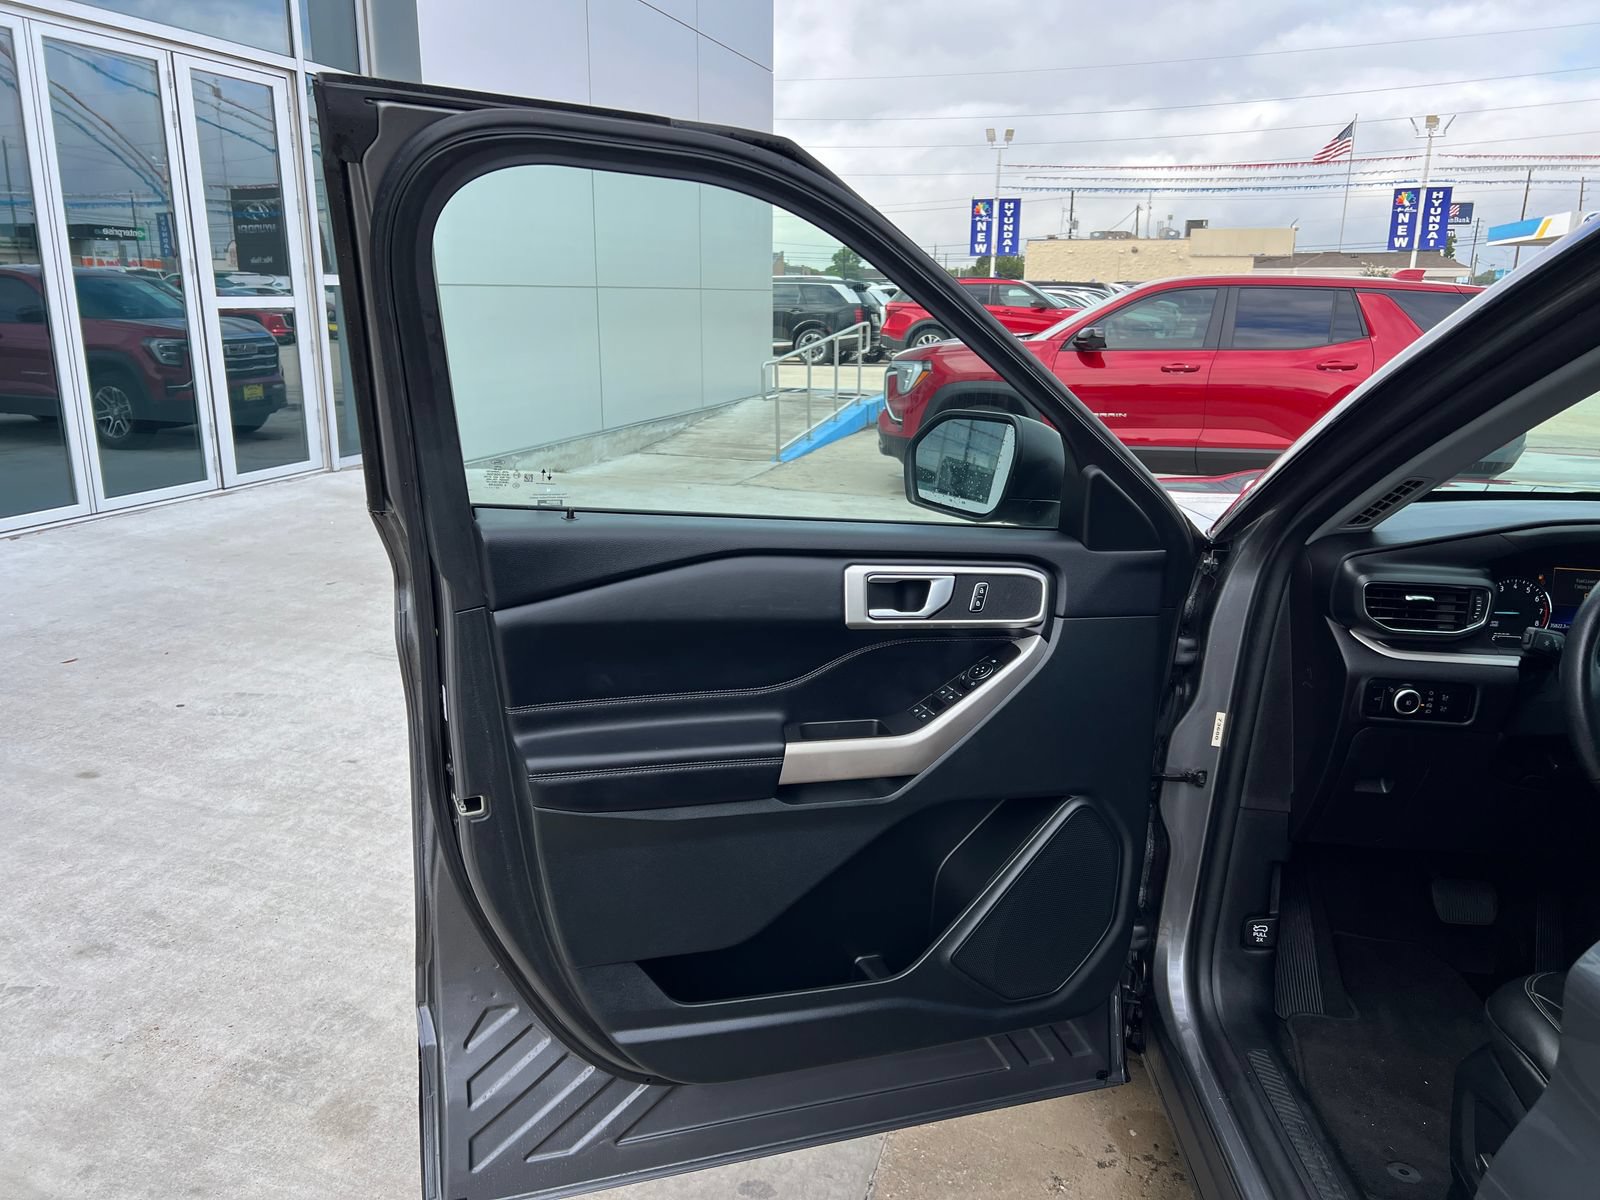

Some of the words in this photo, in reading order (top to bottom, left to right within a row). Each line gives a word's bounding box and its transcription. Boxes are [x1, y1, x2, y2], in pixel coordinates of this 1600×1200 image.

[974, 221, 987, 253] NEW
[1002, 202, 1014, 253] HYUNDAI
[1393, 212, 1410, 248] NEW
[1426, 191, 1444, 247] HYUNDAI
